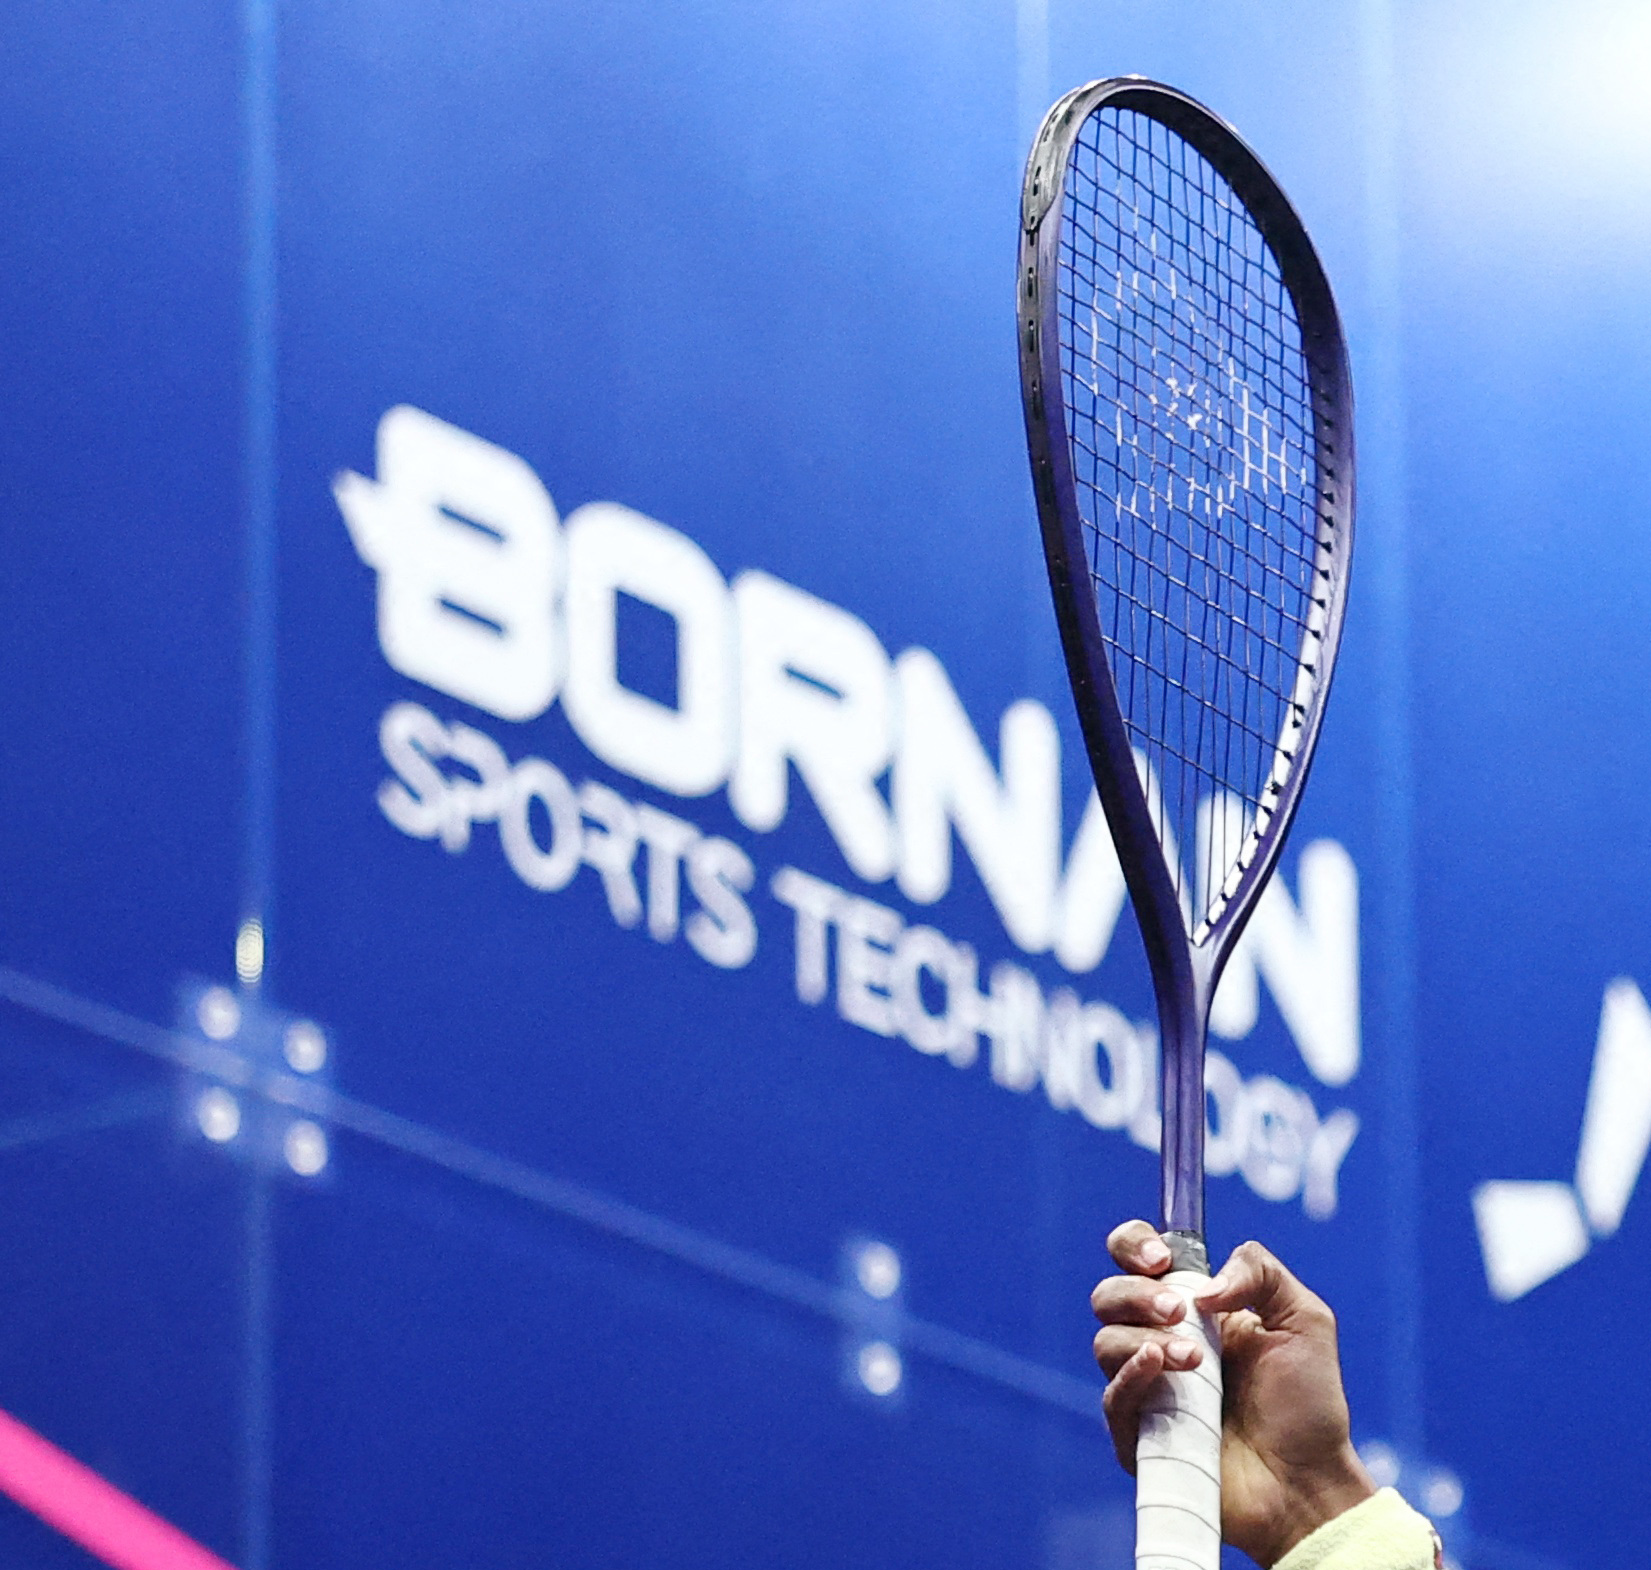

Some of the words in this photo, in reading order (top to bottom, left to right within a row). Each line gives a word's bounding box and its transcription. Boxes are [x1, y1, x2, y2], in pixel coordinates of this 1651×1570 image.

[332, 404, 1361, 1085] BORNAN
[378, 702, 757, 969] SPORTS
[773, 867, 1360, 1221] TECHNOLOGY
